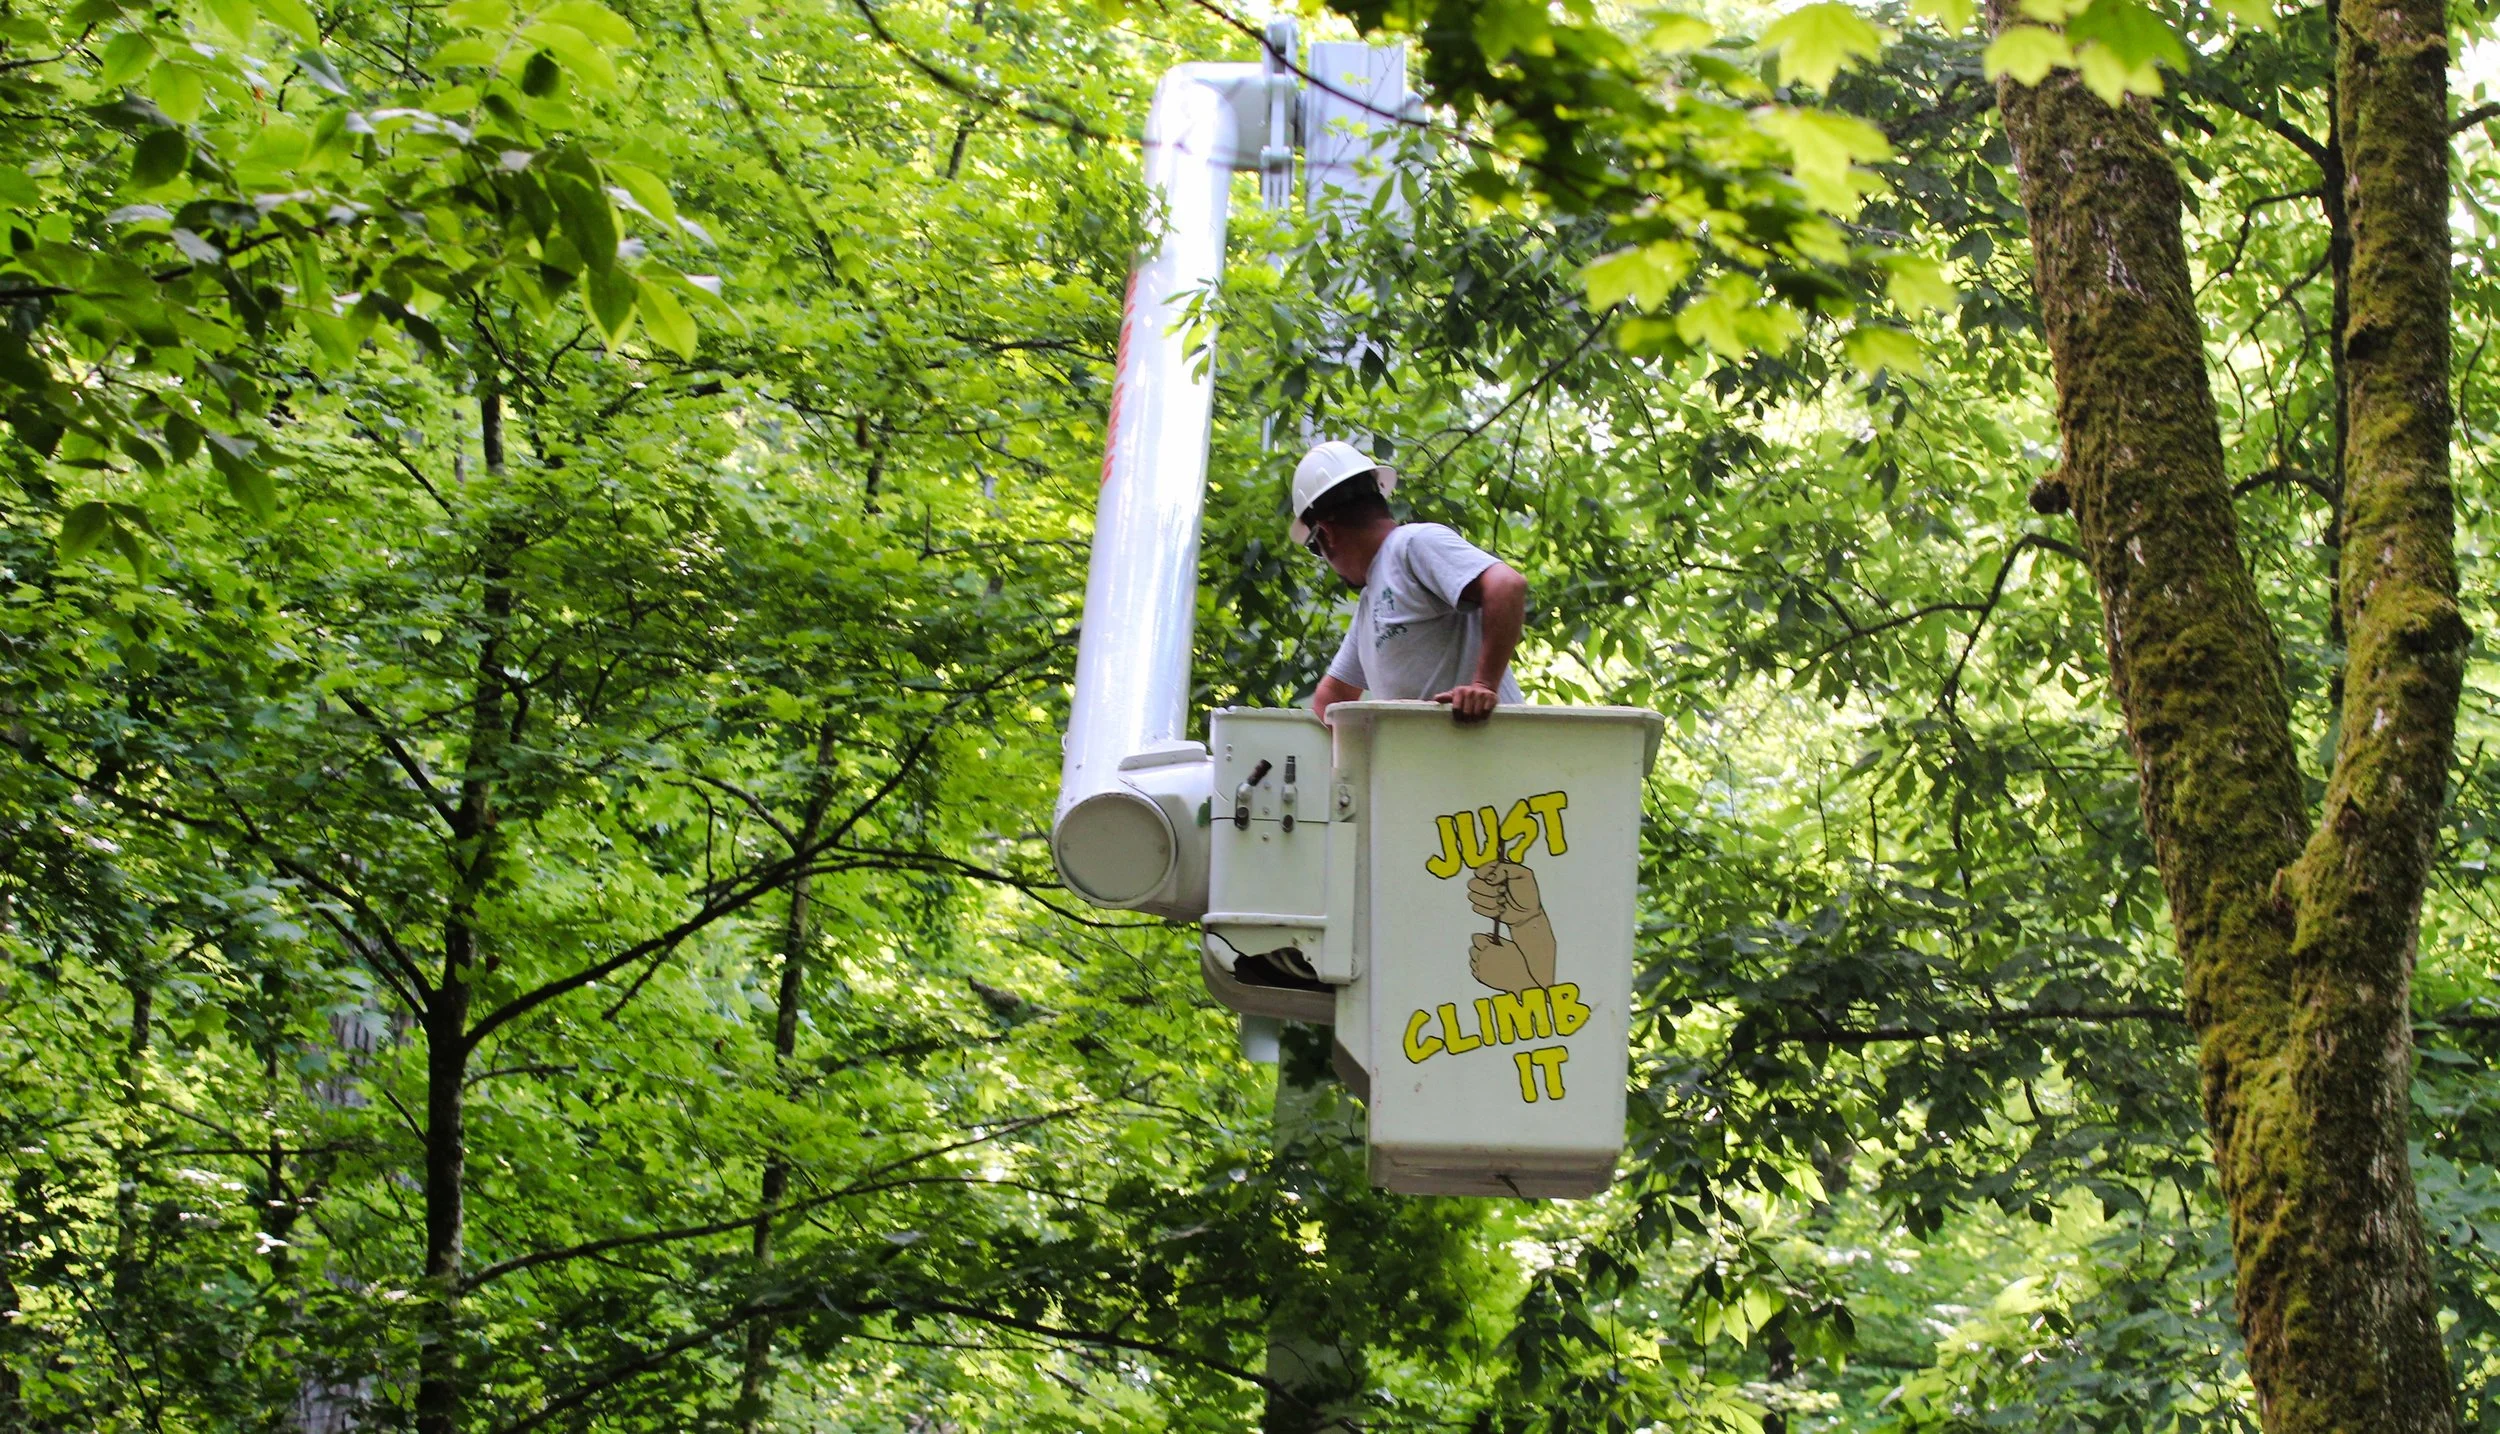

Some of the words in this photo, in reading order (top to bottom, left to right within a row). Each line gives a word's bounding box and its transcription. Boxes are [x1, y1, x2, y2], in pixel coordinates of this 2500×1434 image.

[1426, 791, 1568, 879] JUST
[1403, 982, 1591, 1064] CLIMB
[1514, 1045, 1568, 1103] IT
